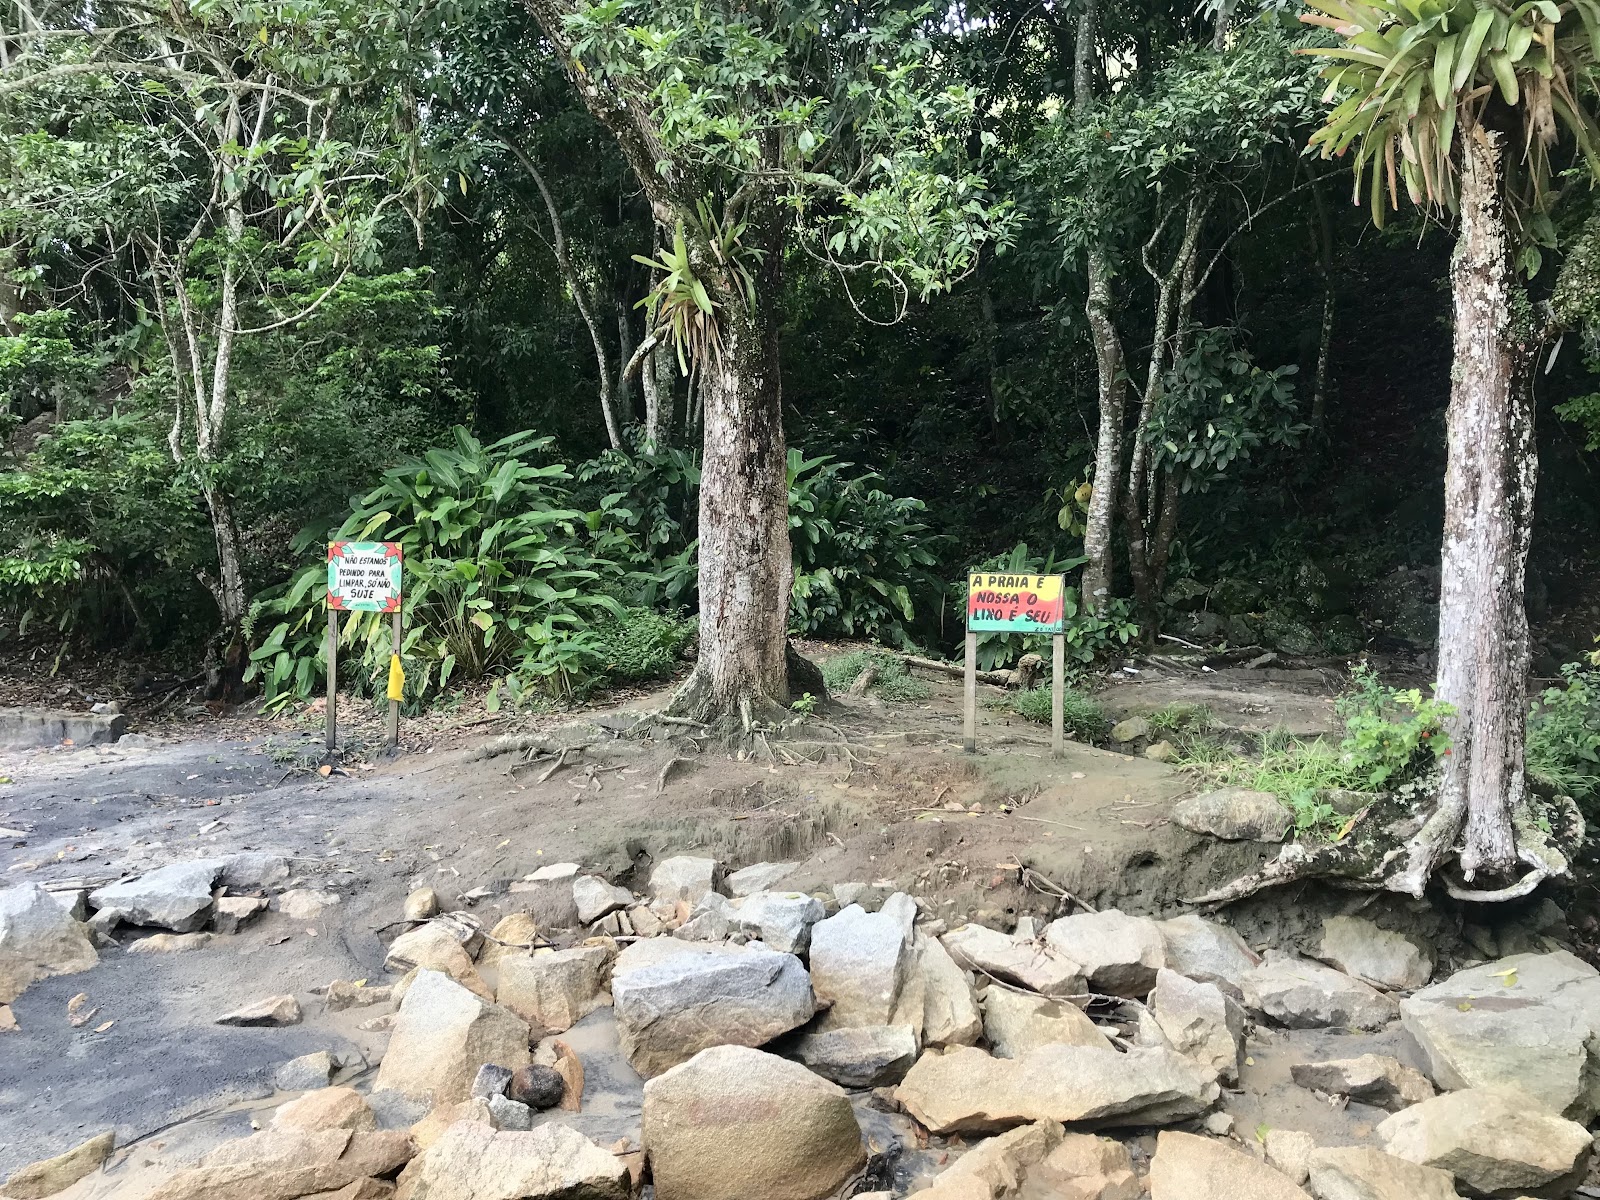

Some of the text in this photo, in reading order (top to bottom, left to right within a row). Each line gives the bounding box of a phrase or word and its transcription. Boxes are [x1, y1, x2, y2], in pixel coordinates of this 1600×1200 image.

[345, 555, 388, 565] NÃO ESTAMOS
[339, 568, 385, 577] PEDINDO PARA
[377, 578, 391, 588] NÃO
[972, 575, 982, 587] A
[988, 575, 1029, 588] PRAIA
[350, 588, 374, 599] SUJE
[976, 591, 1038, 605] NOSSA O
[973, 606, 1051, 623] LIXO É SEU
